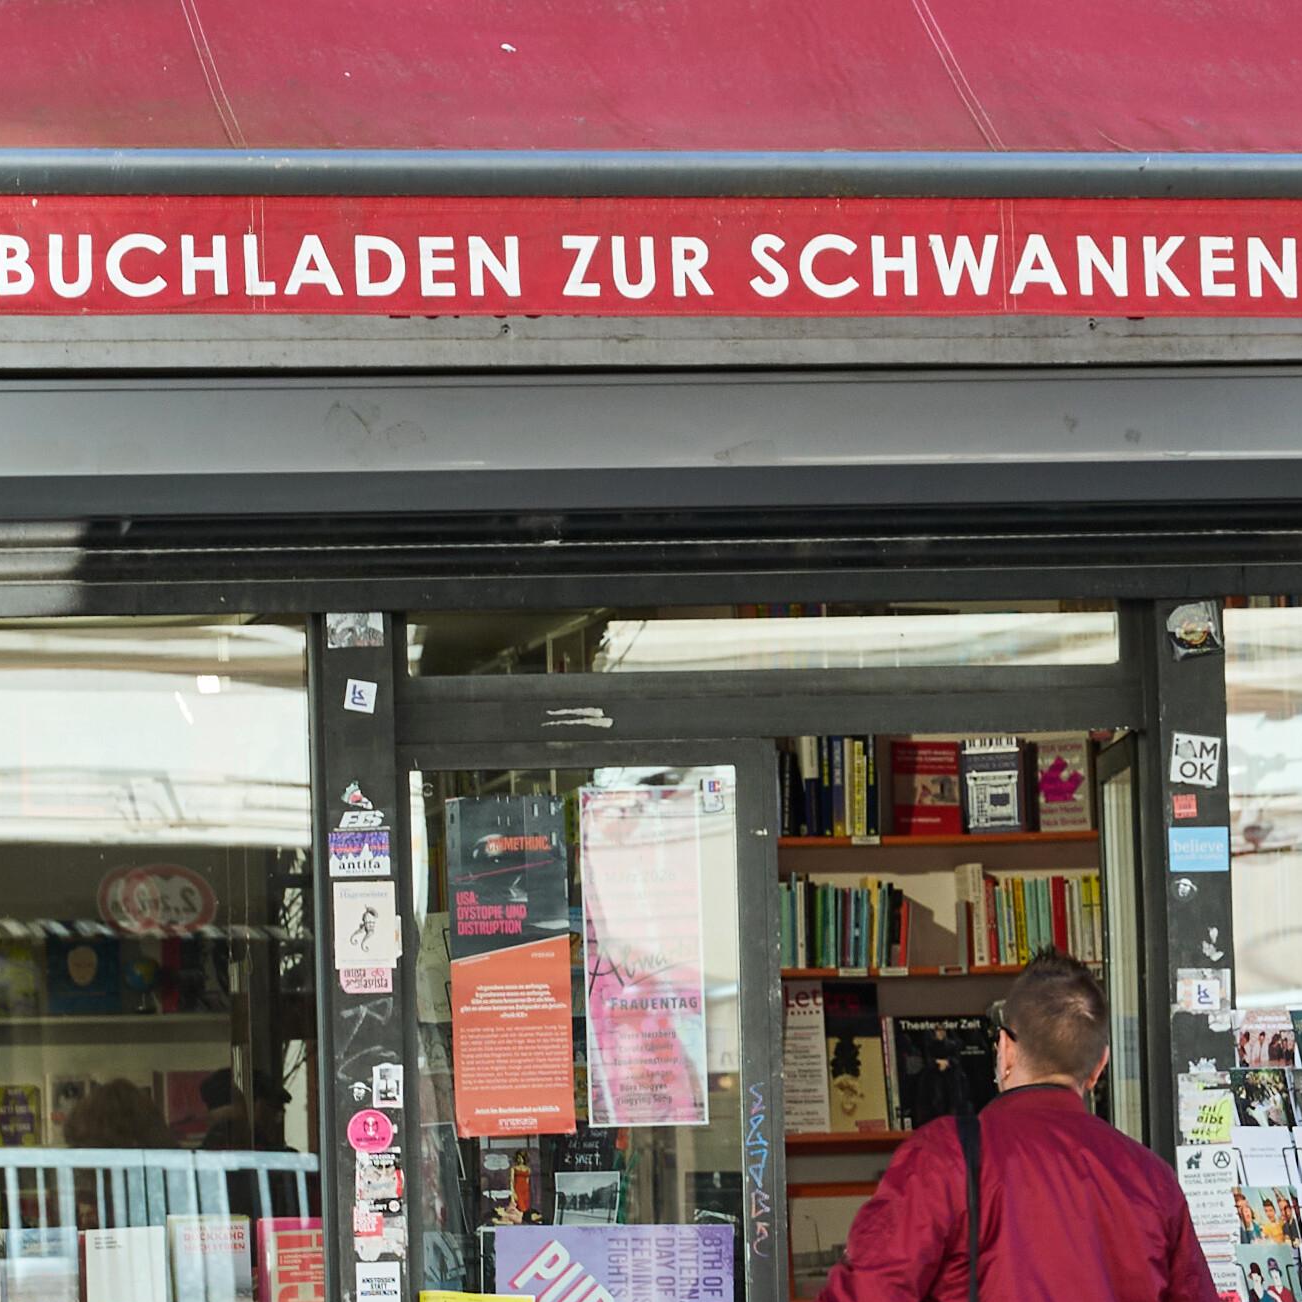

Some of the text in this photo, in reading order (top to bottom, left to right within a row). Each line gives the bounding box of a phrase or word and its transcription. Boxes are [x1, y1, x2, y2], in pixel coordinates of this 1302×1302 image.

[562, 235, 714, 298] ZUR
[1179, 760, 1213, 782] OK
[1173, 839, 1224, 855] believe
[338, 859, 382, 871] antifa
[456, 891, 478, 905] USA:
[456, 905, 527, 920] DYSTOPIE UND
[611, 996, 699, 1010] FRAUENTAG
[960, 1019, 981, 1029] Zeit
[702, 1236, 723, 1272] 8TH
[608, 1237, 628, 1299] FIGHTS
[655, 1237, 676, 1298] DAY OF
[703, 1277, 723, 1297] OF
